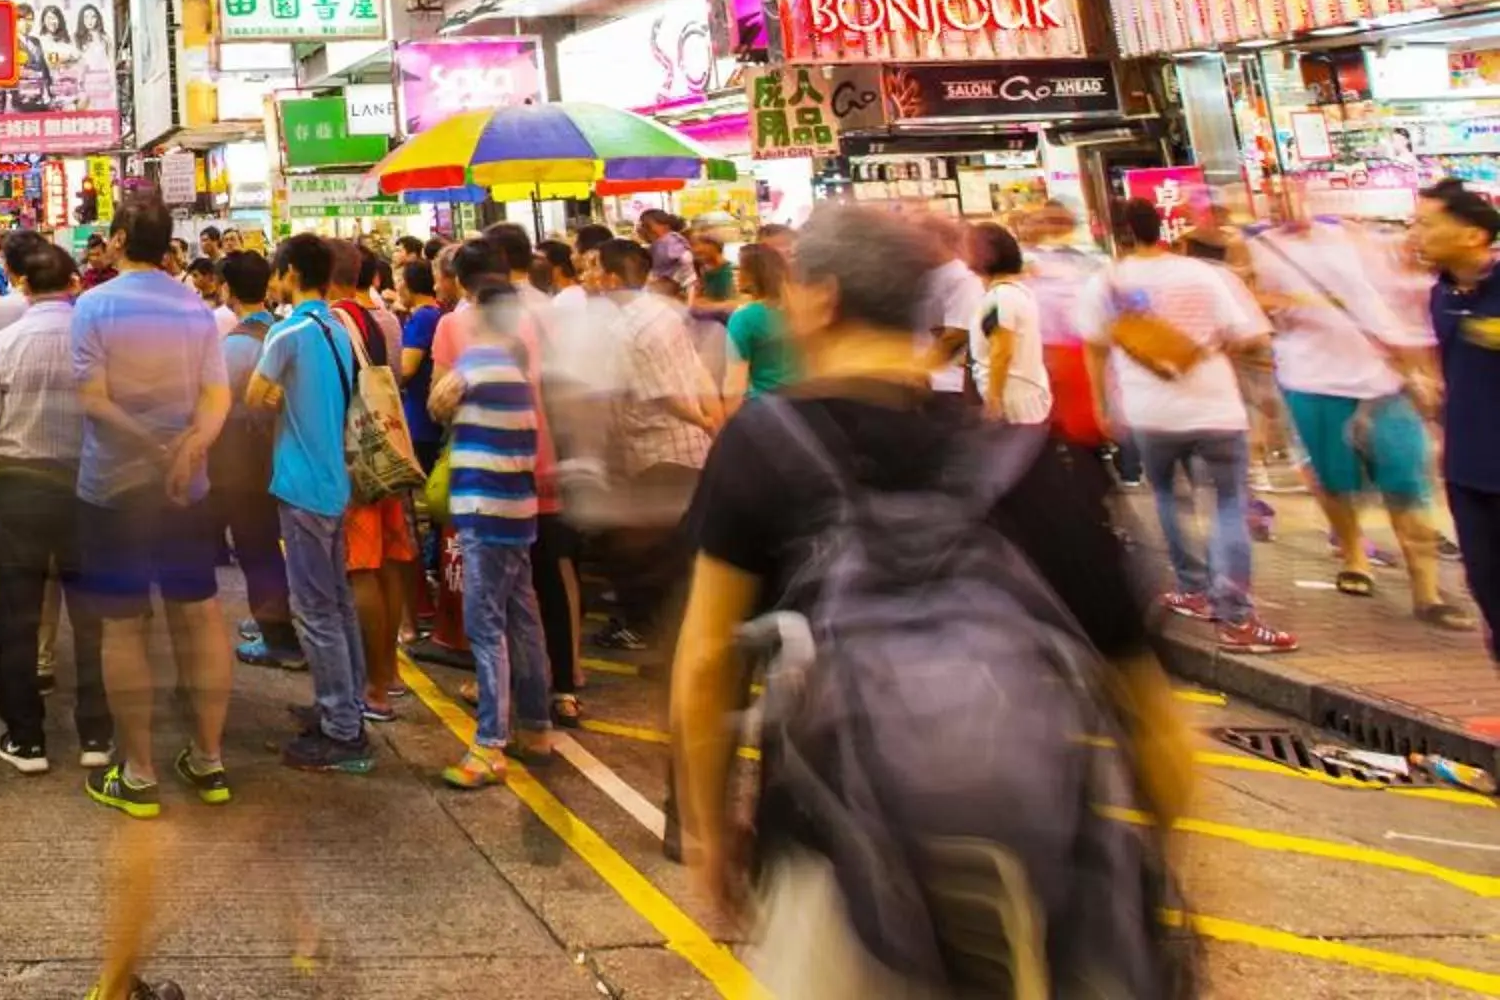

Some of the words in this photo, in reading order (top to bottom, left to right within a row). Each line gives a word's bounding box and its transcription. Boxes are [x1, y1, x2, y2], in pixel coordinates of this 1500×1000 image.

[947, 84, 993, 98] SALON
[1000, 75, 1051, 101] Go
[1055, 81, 1102, 95] AHEAD
